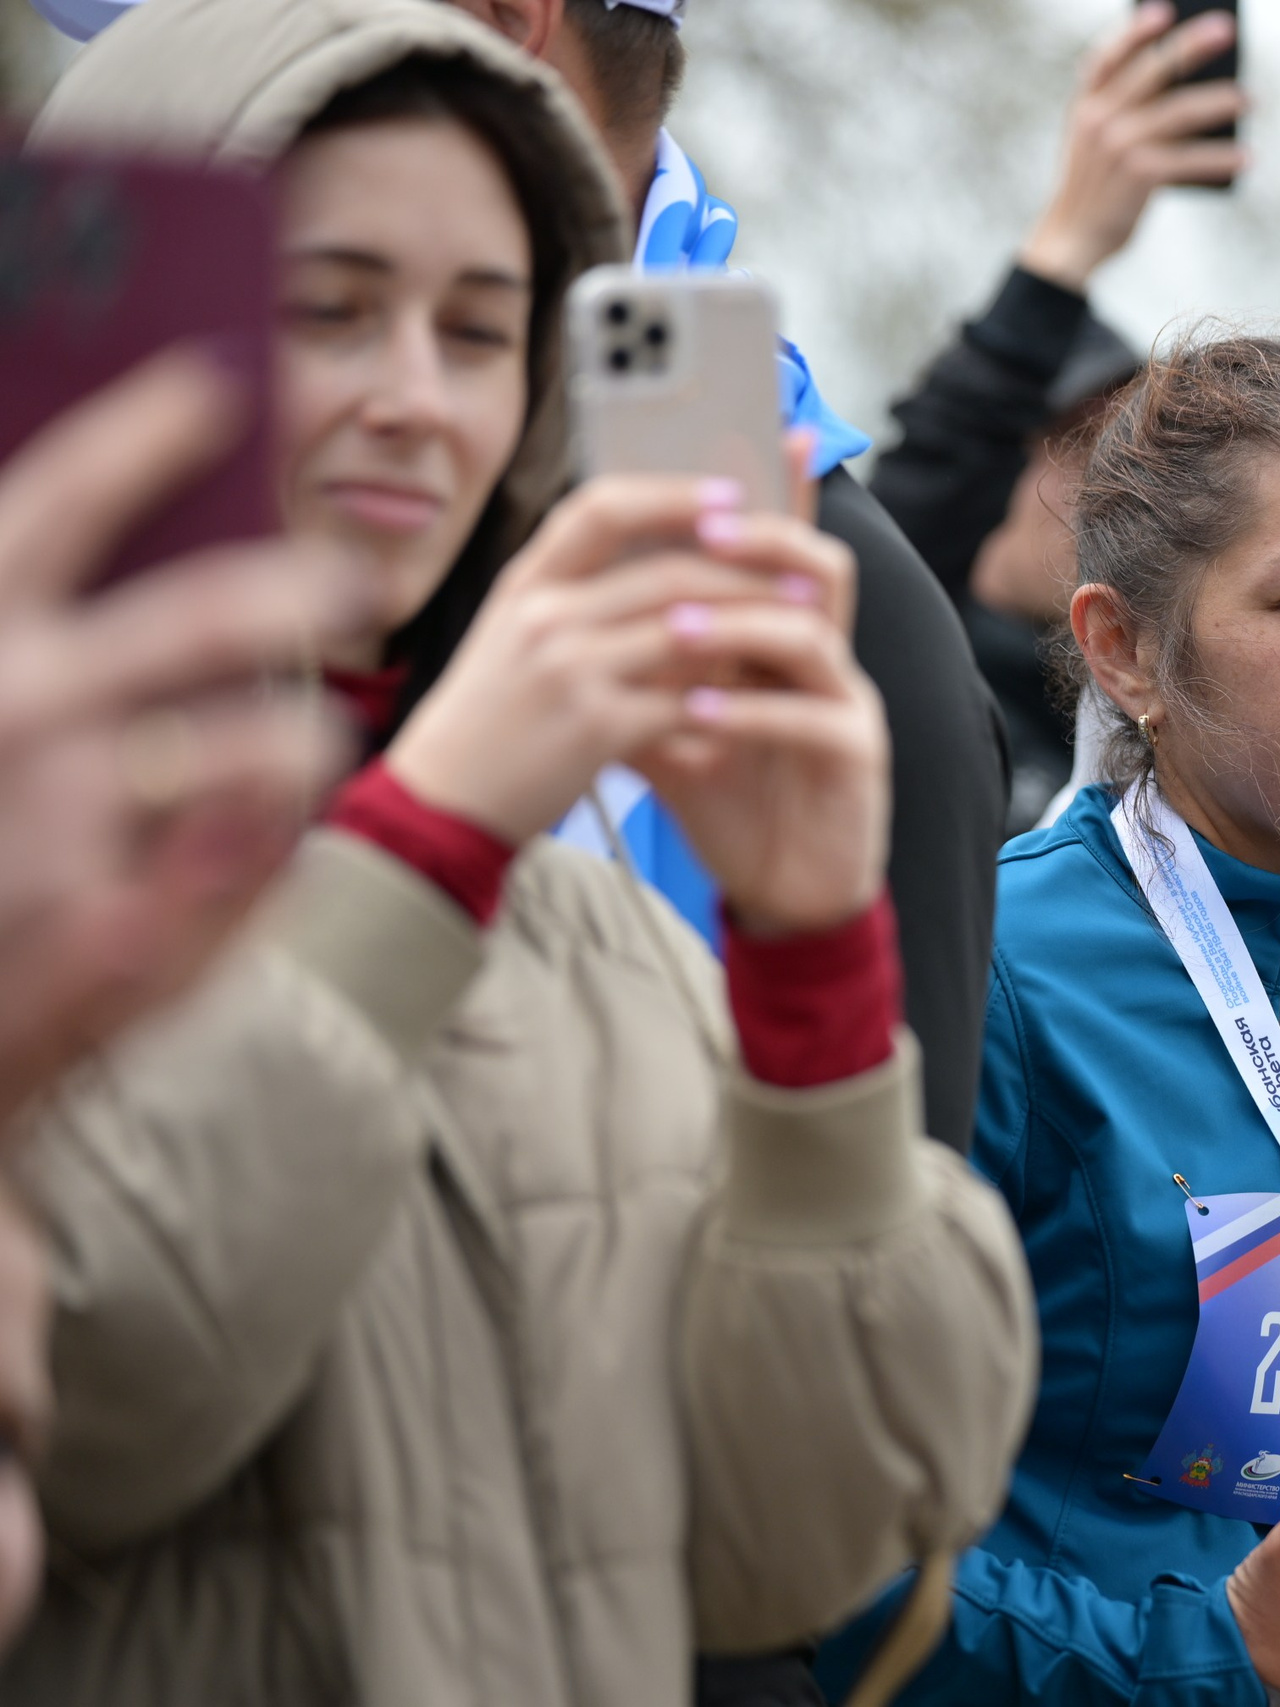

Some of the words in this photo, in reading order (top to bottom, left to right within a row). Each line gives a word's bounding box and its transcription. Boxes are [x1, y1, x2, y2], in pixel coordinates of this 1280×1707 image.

[1155, 841, 1194, 910] Отечественно
[1177, 905, 1200, 942] Кубани
[1189, 890, 1209, 921] годов
[1189, 911, 1217, 955] Великой
[1204, 921, 1232, 970] 1941-1945
[1198, 942, 1234, 1009] Спортсмены
[1213, 956, 1221, 964] в
[1217, 964, 1242, 1006] Победы
[1229, 970, 1249, 1003] войне
